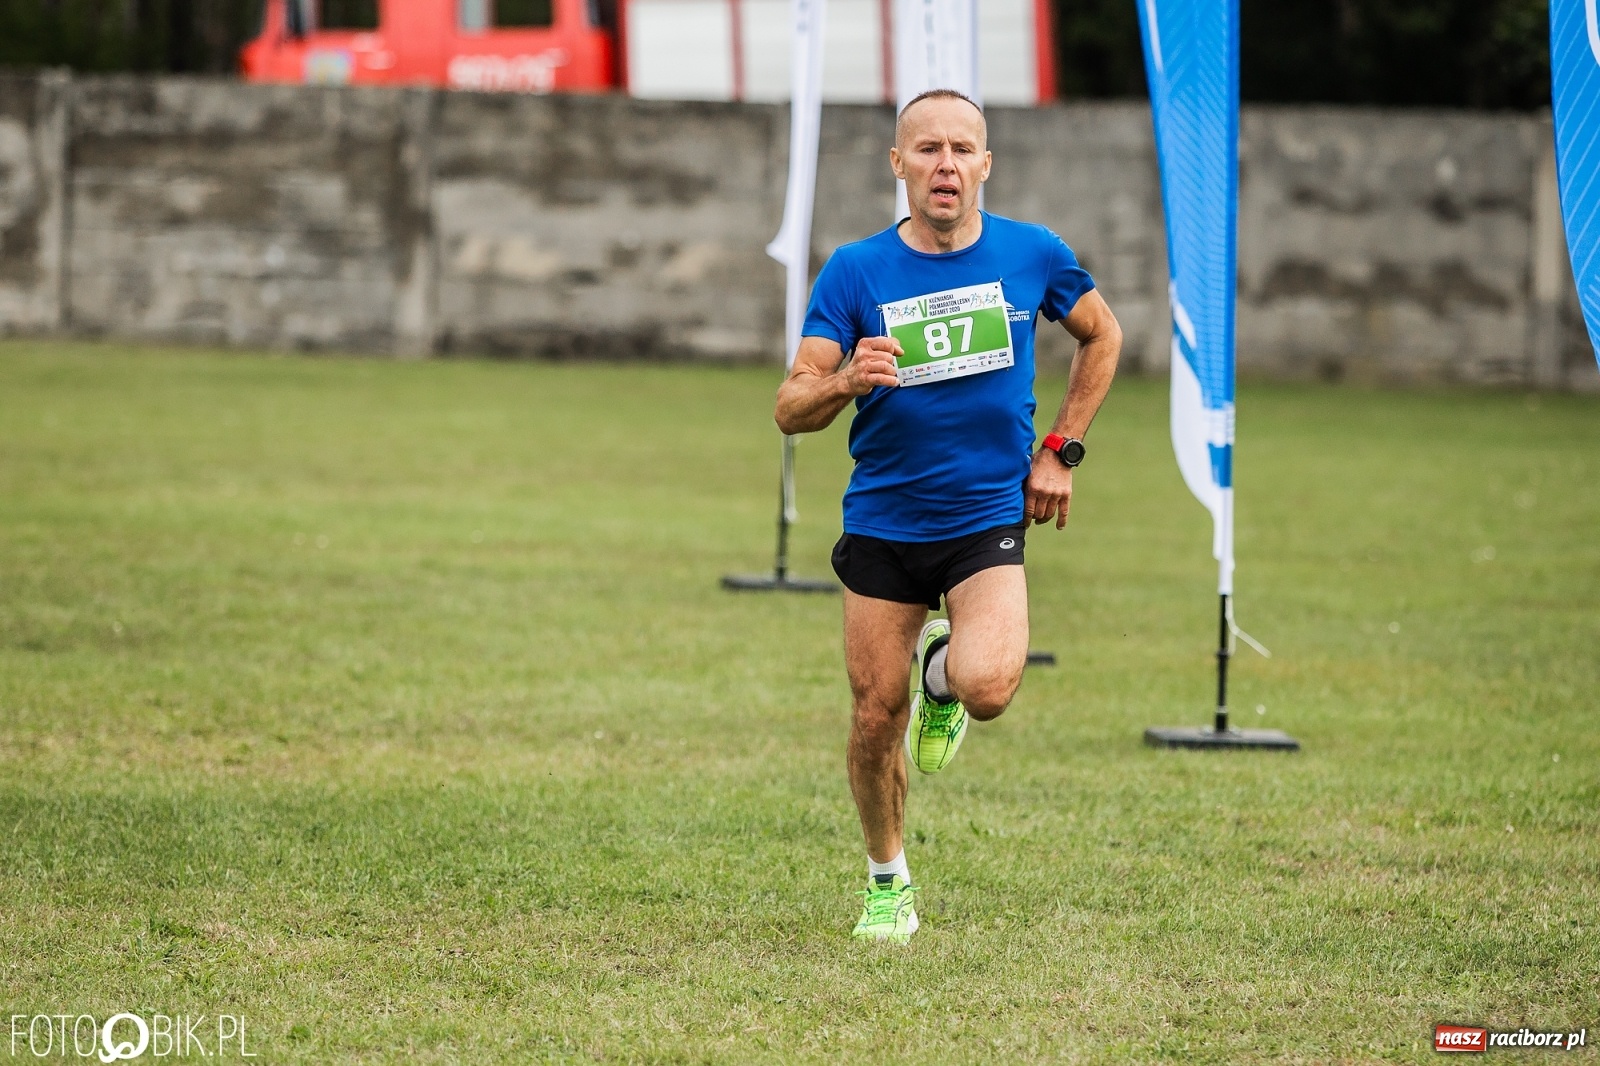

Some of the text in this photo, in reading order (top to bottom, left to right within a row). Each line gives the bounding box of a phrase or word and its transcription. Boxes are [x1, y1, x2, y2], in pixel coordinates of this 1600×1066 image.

[917, 298, 928, 319] V
[929, 299, 957, 310] PÓŁMARATON
[929, 305, 961, 317] RAFAMET 2020
[923, 316, 974, 359] 87
